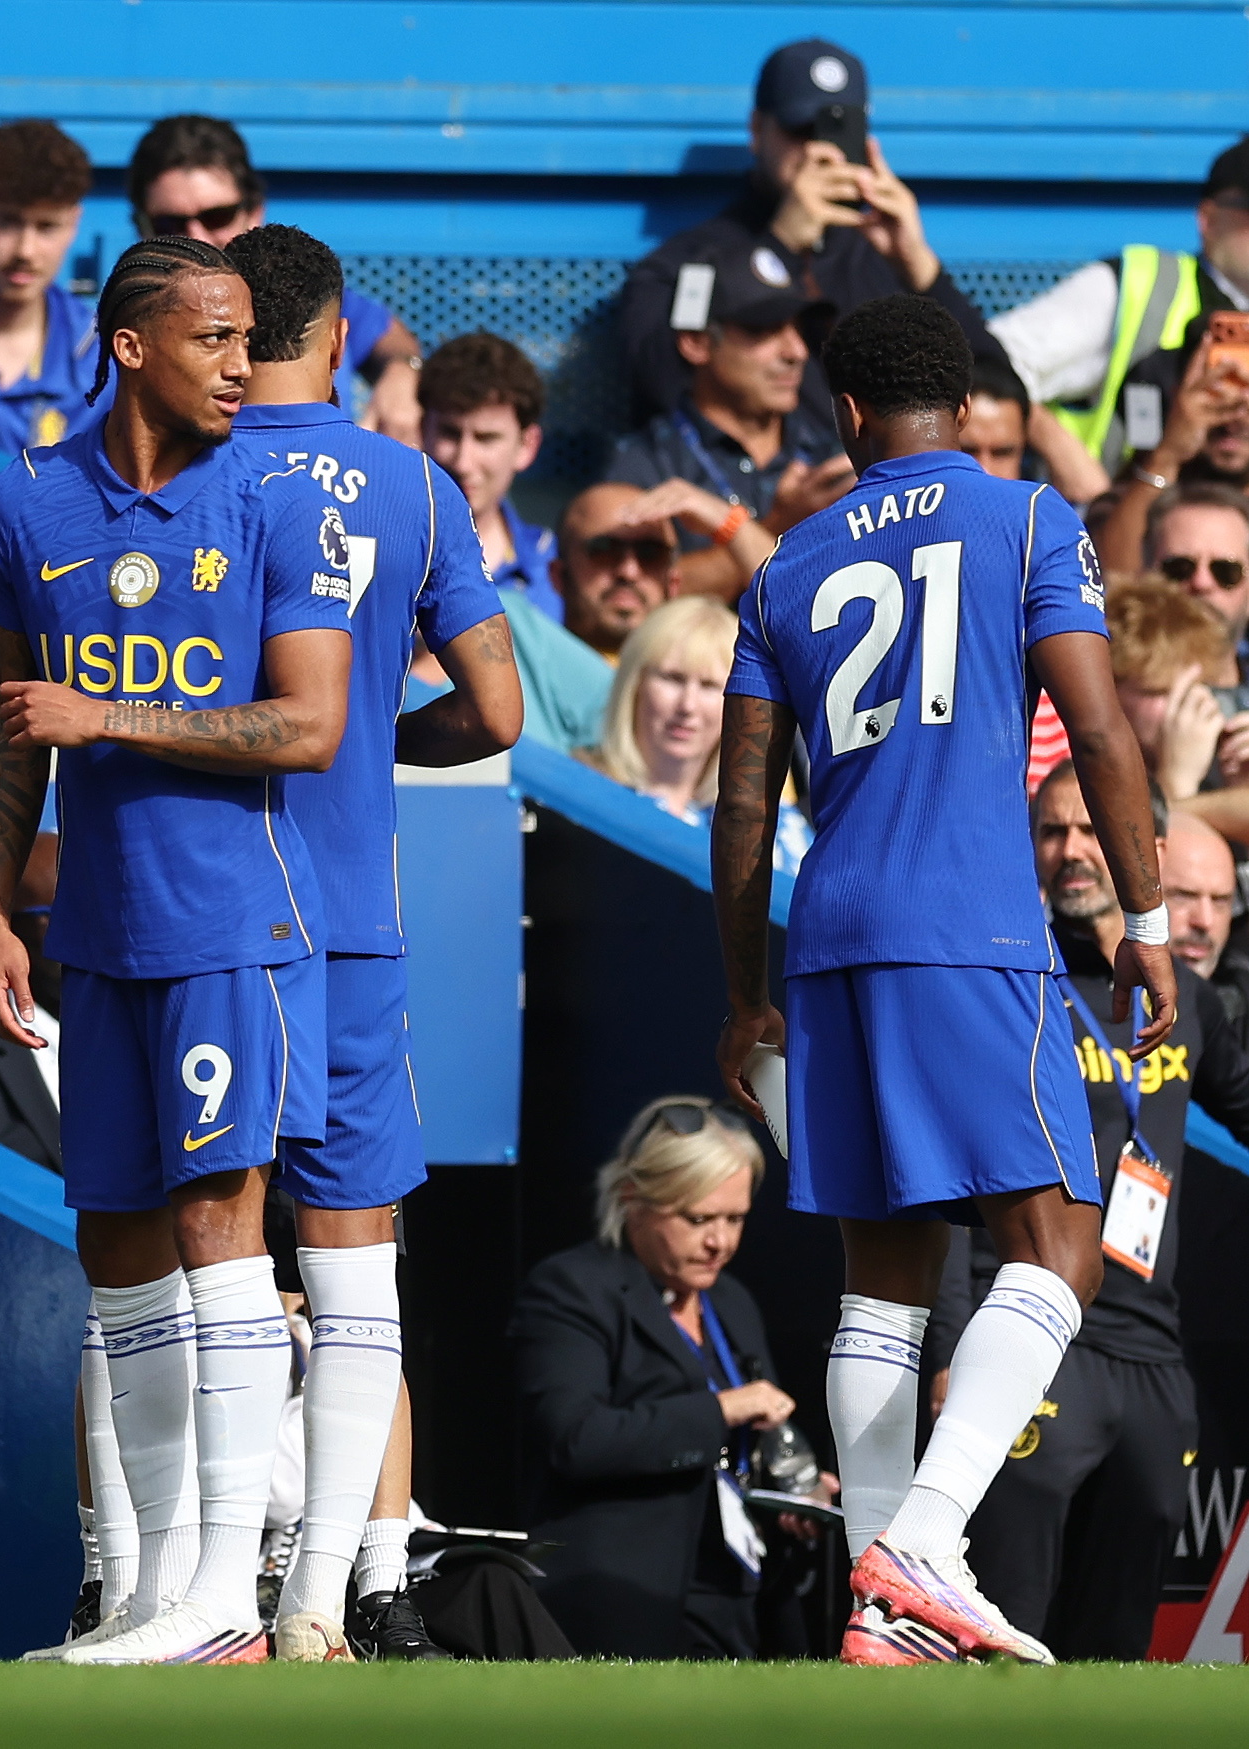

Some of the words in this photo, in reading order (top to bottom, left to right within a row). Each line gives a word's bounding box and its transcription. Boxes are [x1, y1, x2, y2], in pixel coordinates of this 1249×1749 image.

[845, 482, 945, 541] HATO
[118, 594, 139, 604] FIFA
[39, 633, 223, 697] USDC
[811, 541, 963, 757] 21
[181, 1043, 233, 1124] 9
[346, 1325, 394, 1339] CFC
[835, 1338, 871, 1349] CFC
